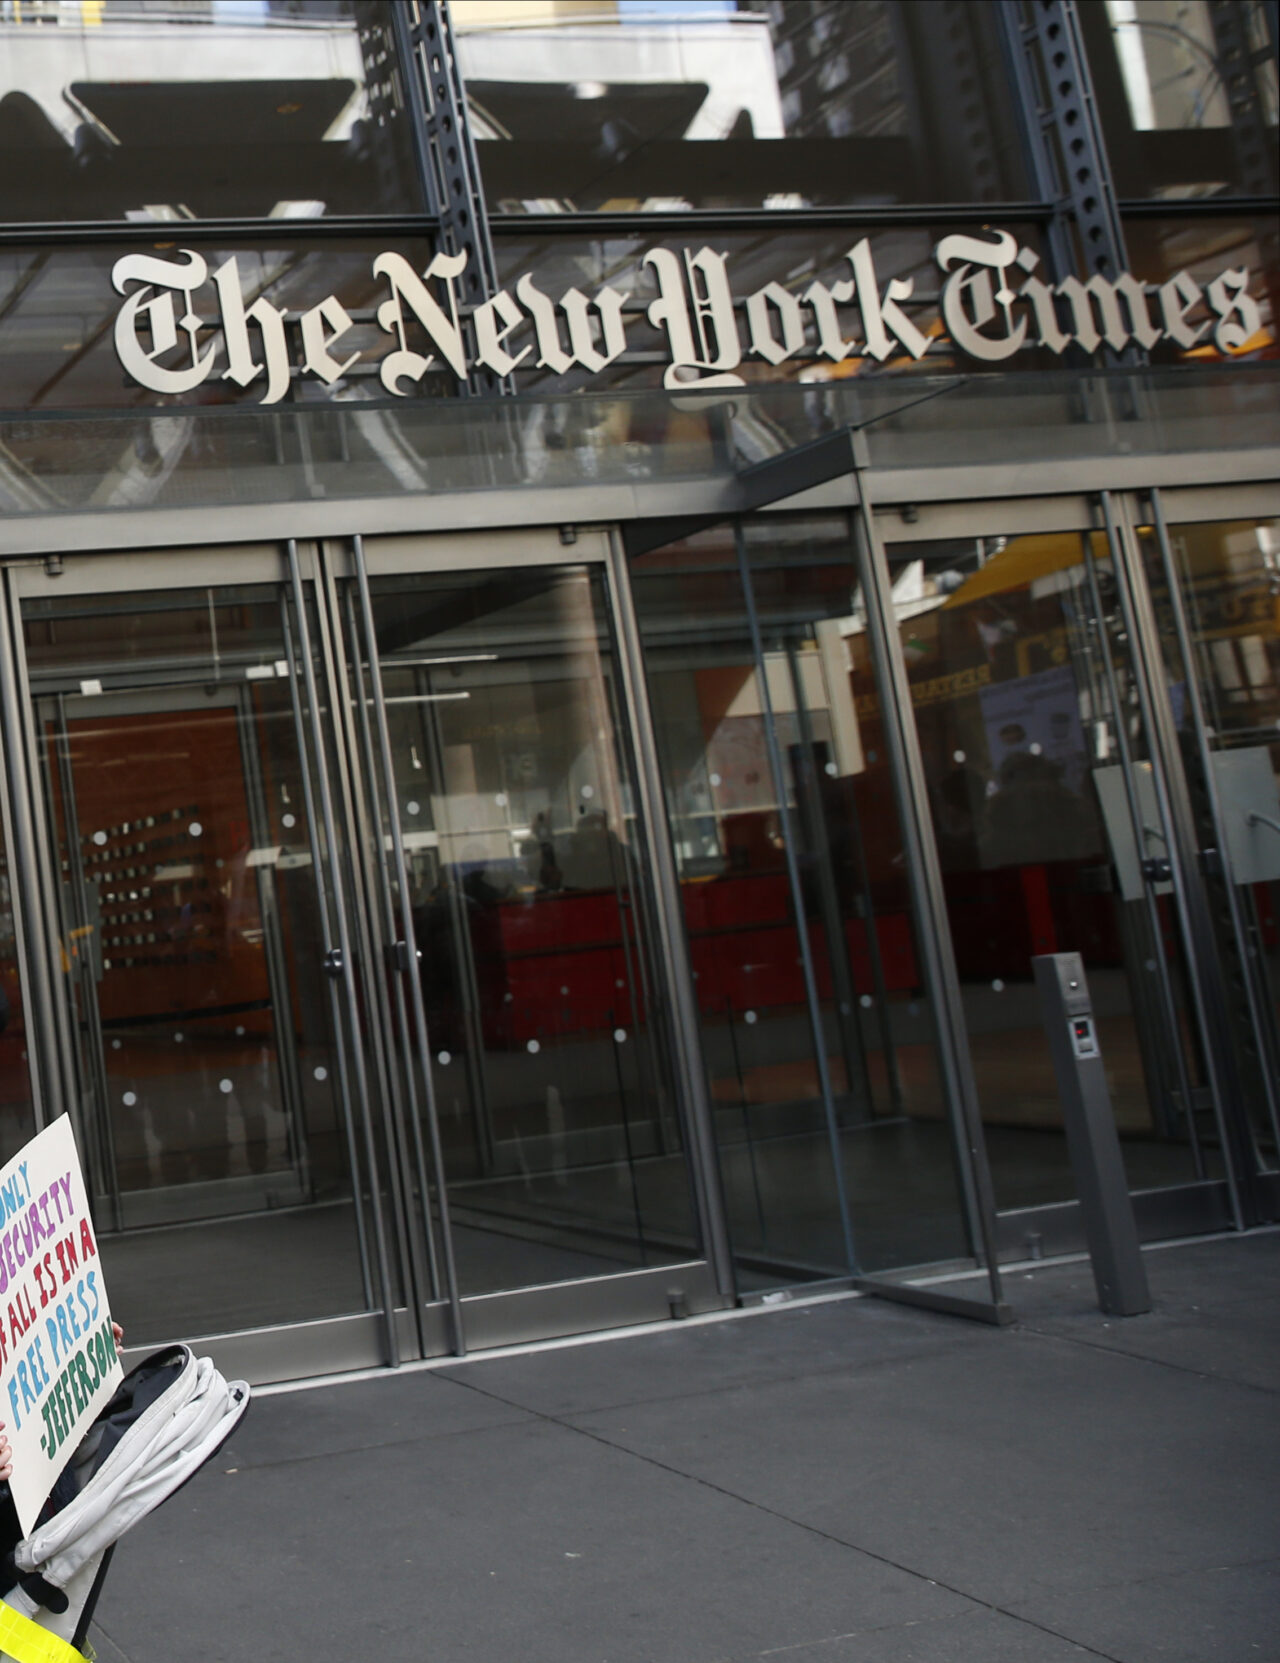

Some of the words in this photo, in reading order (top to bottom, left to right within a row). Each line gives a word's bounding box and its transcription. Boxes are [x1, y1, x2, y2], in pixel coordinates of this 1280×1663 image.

[111, 248, 361, 405] The
[372, 248, 630, 398] New
[642, 236, 934, 391] York
[936, 228, 1263, 361] Times
[7, 1283, 37, 1350] ALL
[33, 1252, 58, 1310] IS
[56, 1231, 79, 1284] IN
[79, 1217, 96, 1262] A
[7, 1334, 50, 1432] FREE
[45, 1270, 100, 1369] PRESS
[40, 1314, 117, 1461] -JEFFERSON
